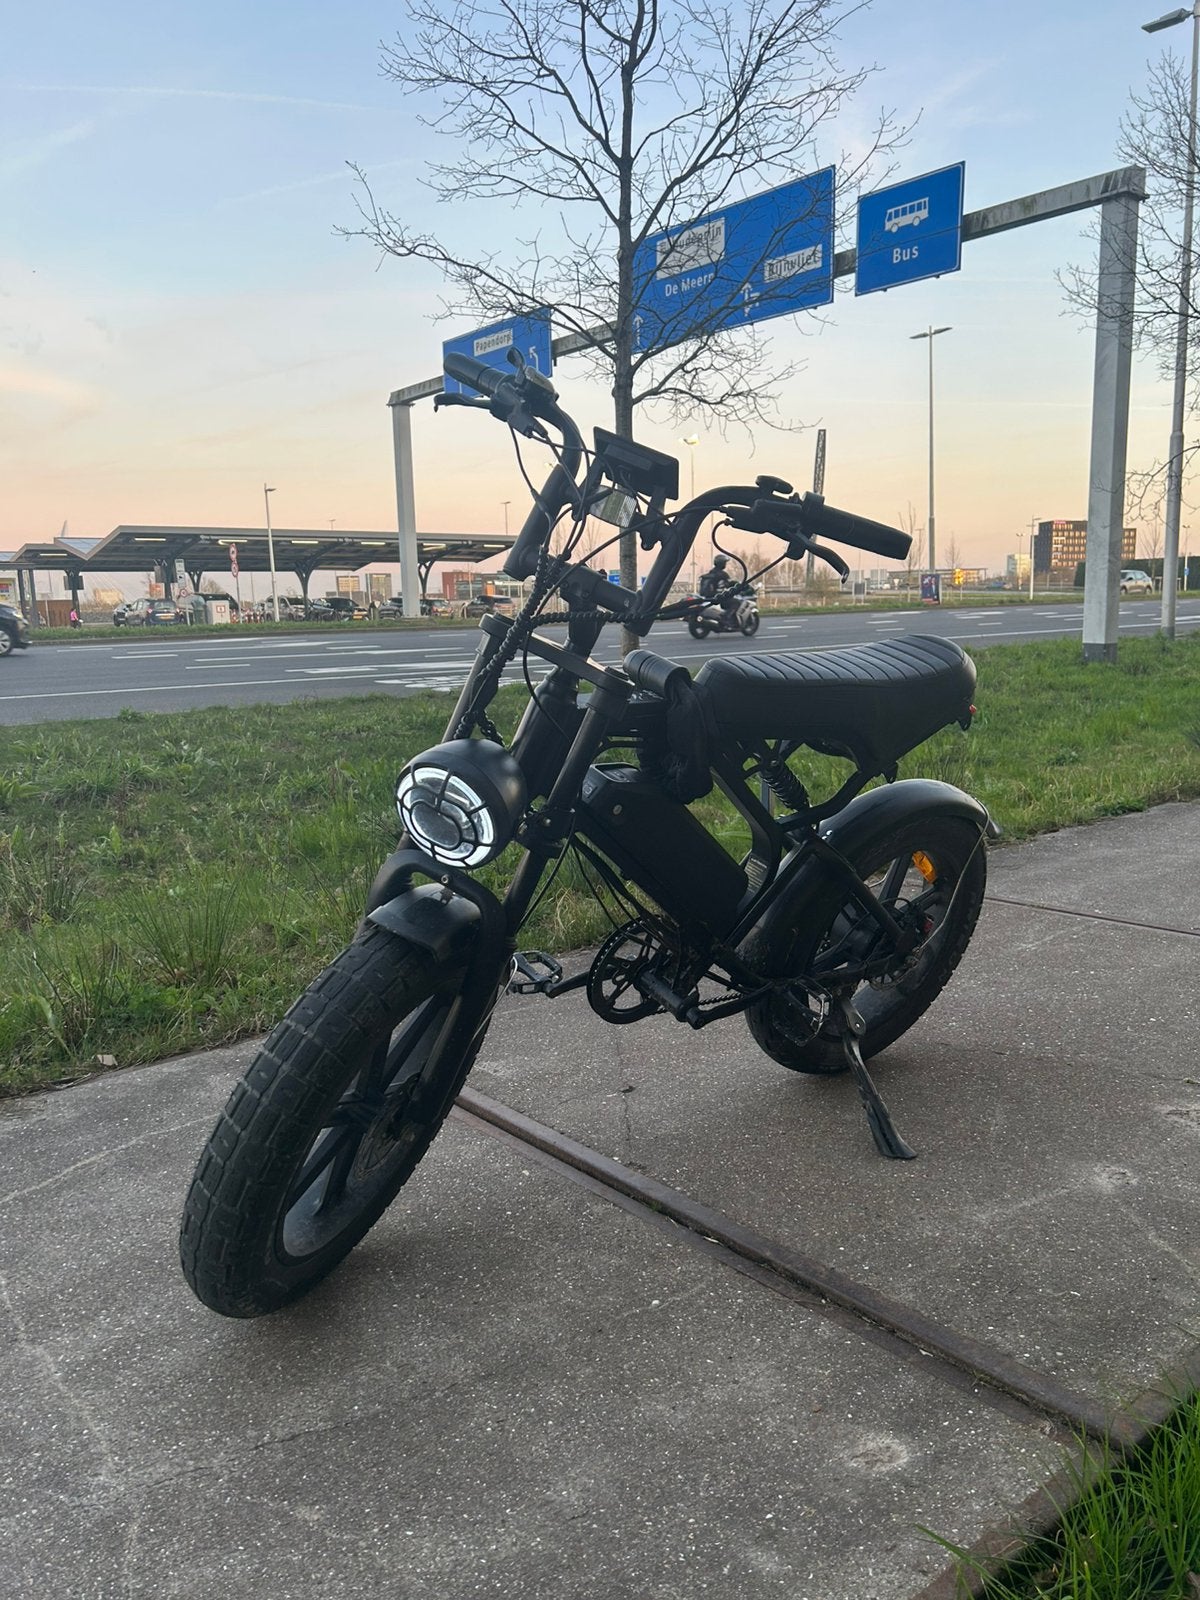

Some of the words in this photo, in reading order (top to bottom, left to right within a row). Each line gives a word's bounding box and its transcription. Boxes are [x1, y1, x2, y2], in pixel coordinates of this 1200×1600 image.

[893, 246, 919, 263] Bus
[665, 283, 679, 297] De
[475, 333, 512, 352] Papendorp
